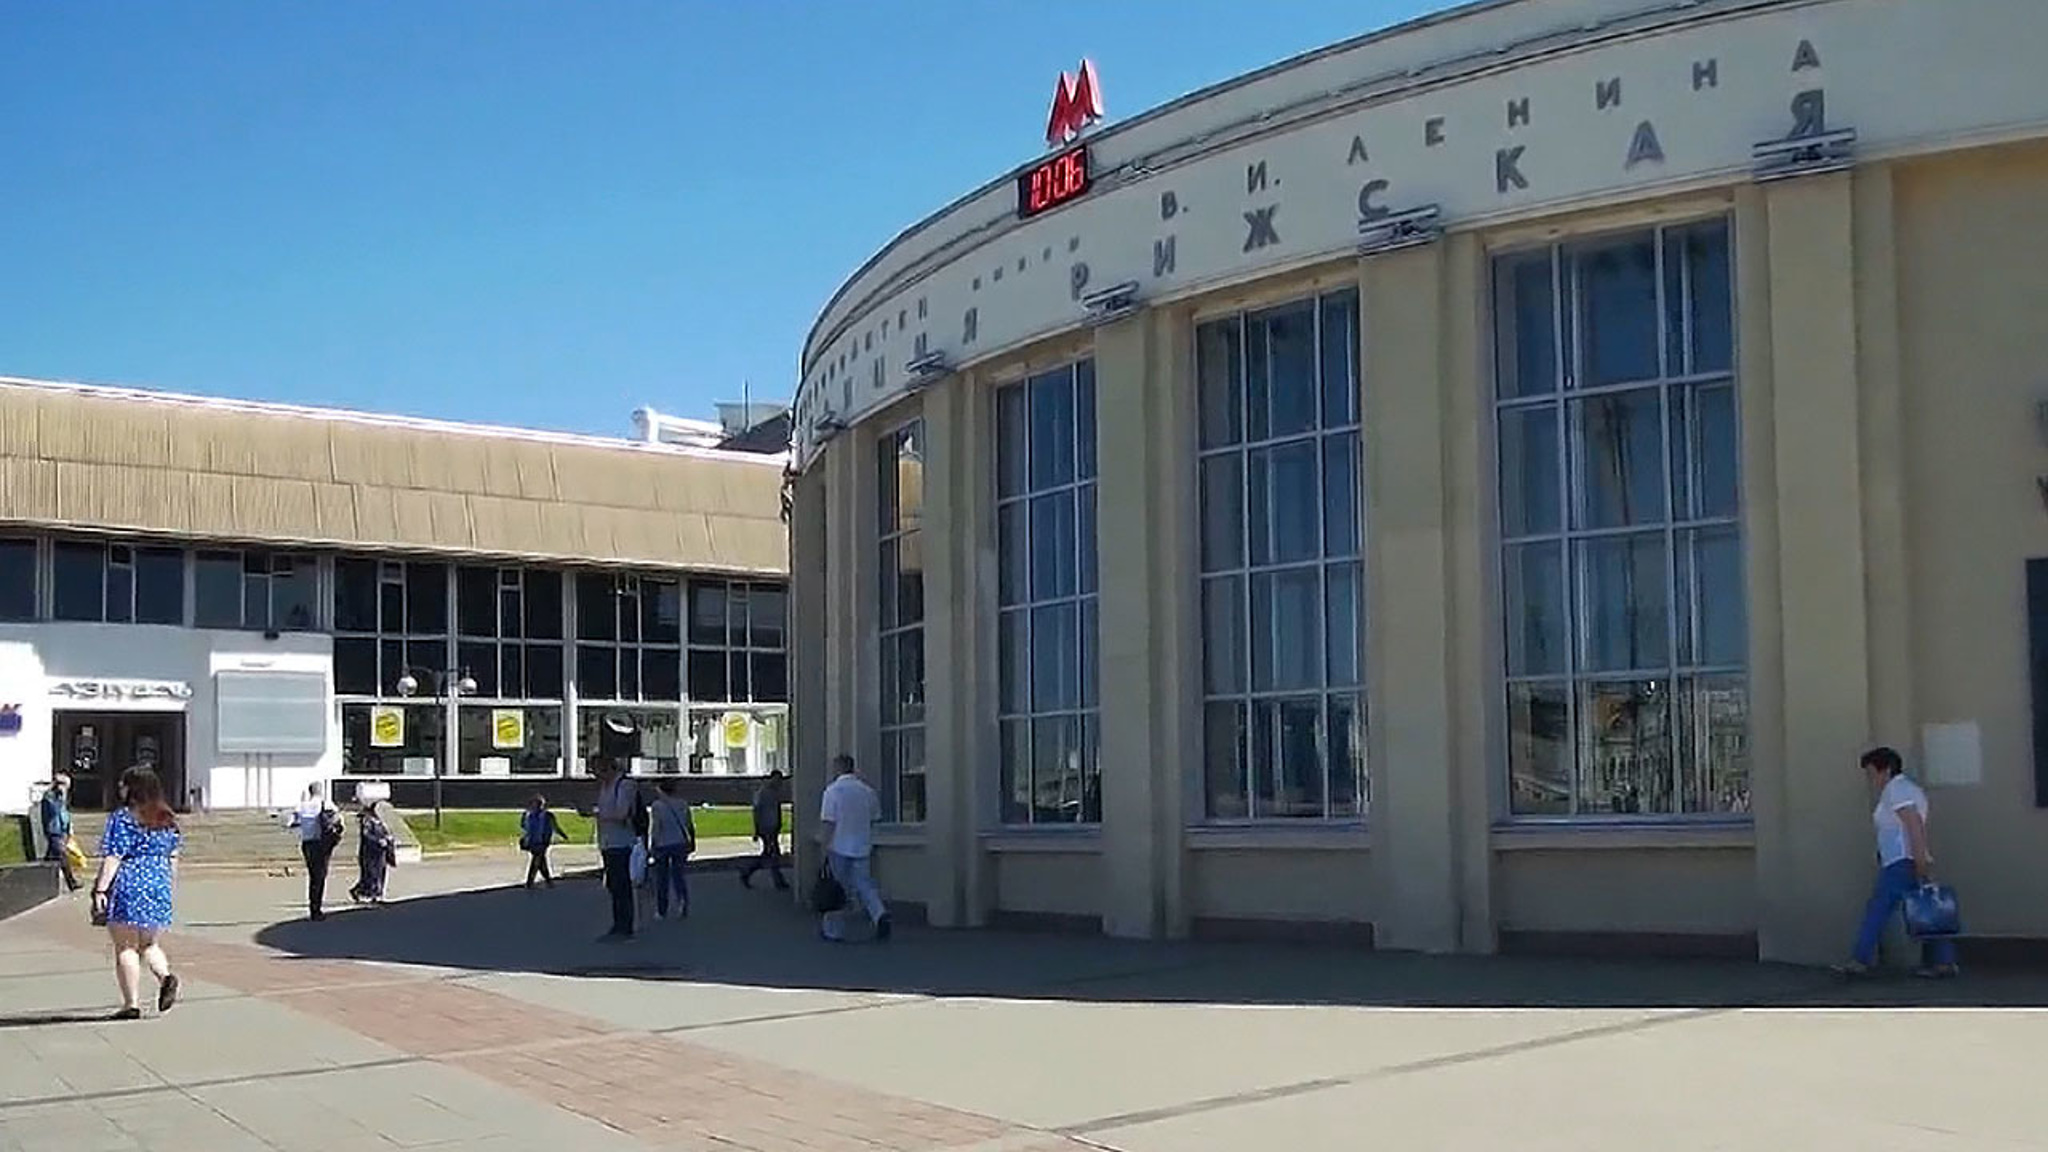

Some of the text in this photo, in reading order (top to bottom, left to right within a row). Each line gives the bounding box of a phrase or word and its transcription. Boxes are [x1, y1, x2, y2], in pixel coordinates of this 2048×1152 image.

[1046, 57, 1104, 146] М
[1347, 39, 1821, 165] ЛЕНИНА
[1071, 88, 1826, 301] РИЖСКАЯ
